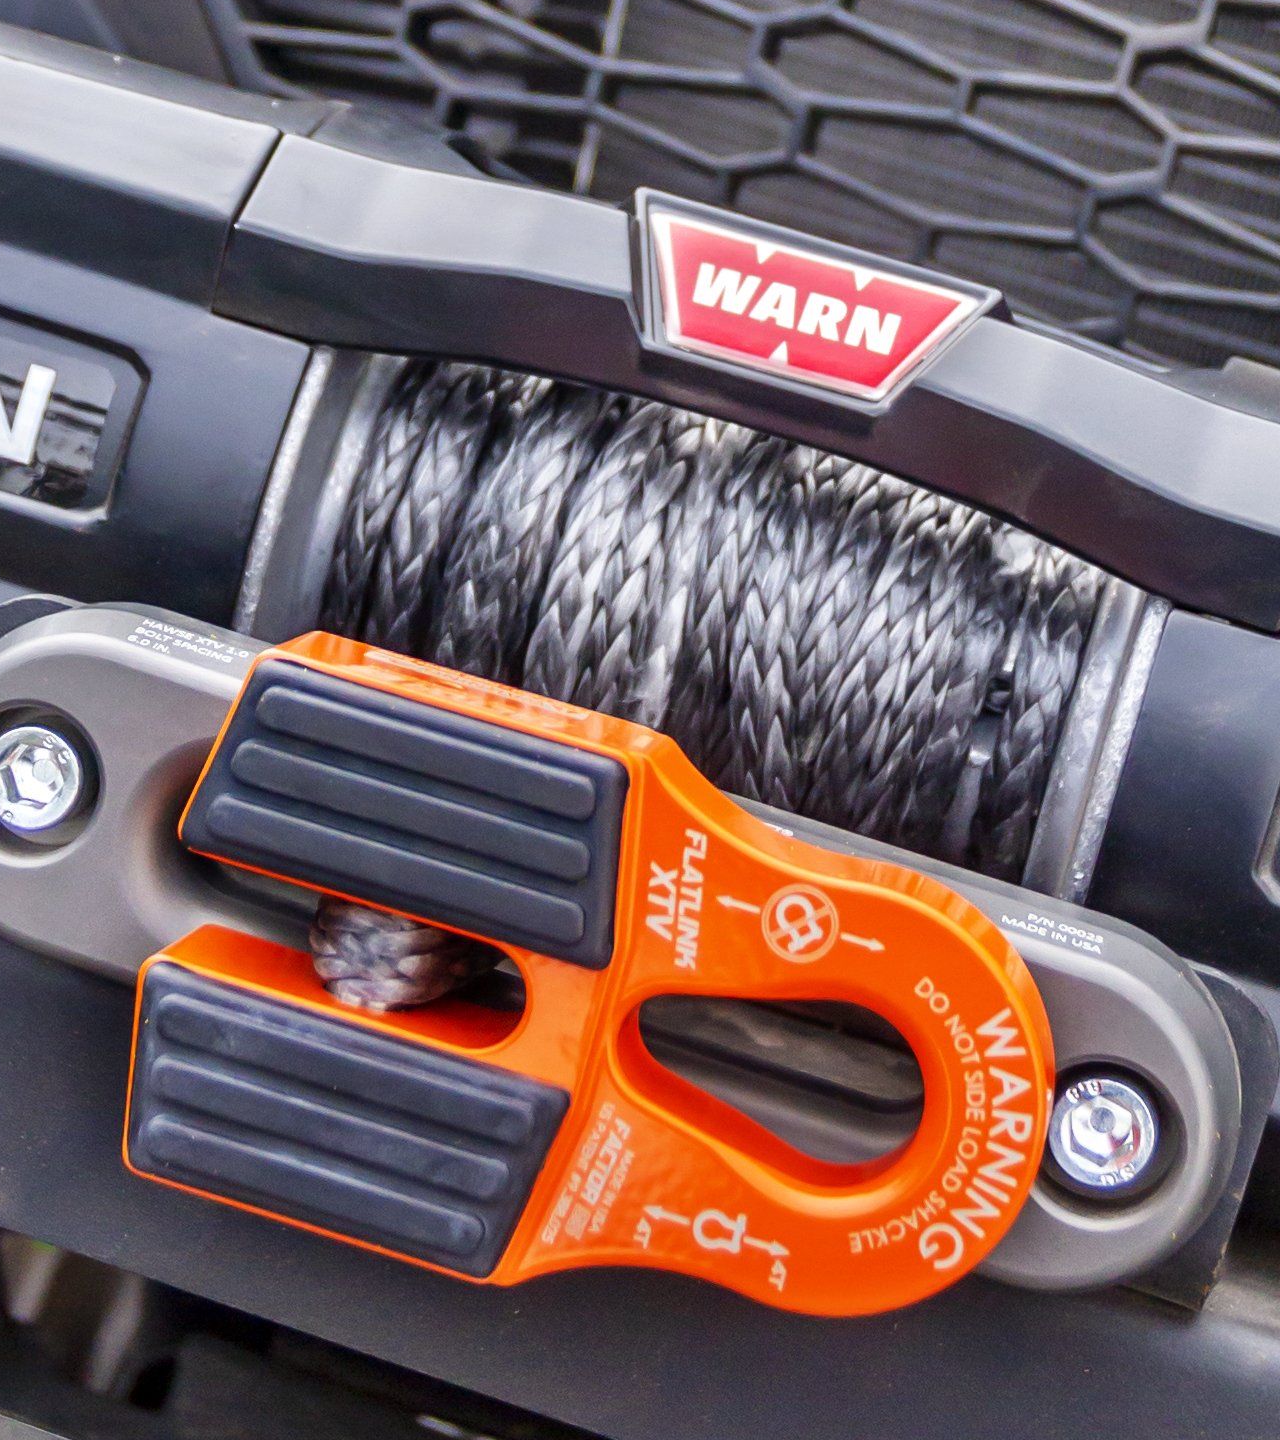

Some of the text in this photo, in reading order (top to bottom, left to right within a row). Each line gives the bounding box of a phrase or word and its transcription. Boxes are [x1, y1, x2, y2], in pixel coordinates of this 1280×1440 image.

[692, 262, 901, 355] WARN
[127, 634, 171, 654] 6.0 IN.
[134, 626, 234, 663] BOLT SPACING
[142, 619, 250, 658] HAWSE XTV 1.0
[645, 860, 678, 941] XTV
[673, 828, 708, 971] FLATLINK
[1001, 915, 1102, 954] MADE IN USA
[1027, 913, 1055, 928] P/N
[848, 976, 986, 1254] DO NOT SIDE LOAD SHACKLE
[918, 1007, 1033, 1270] WARNING
[580, 1117, 631, 1206] FACTOR
